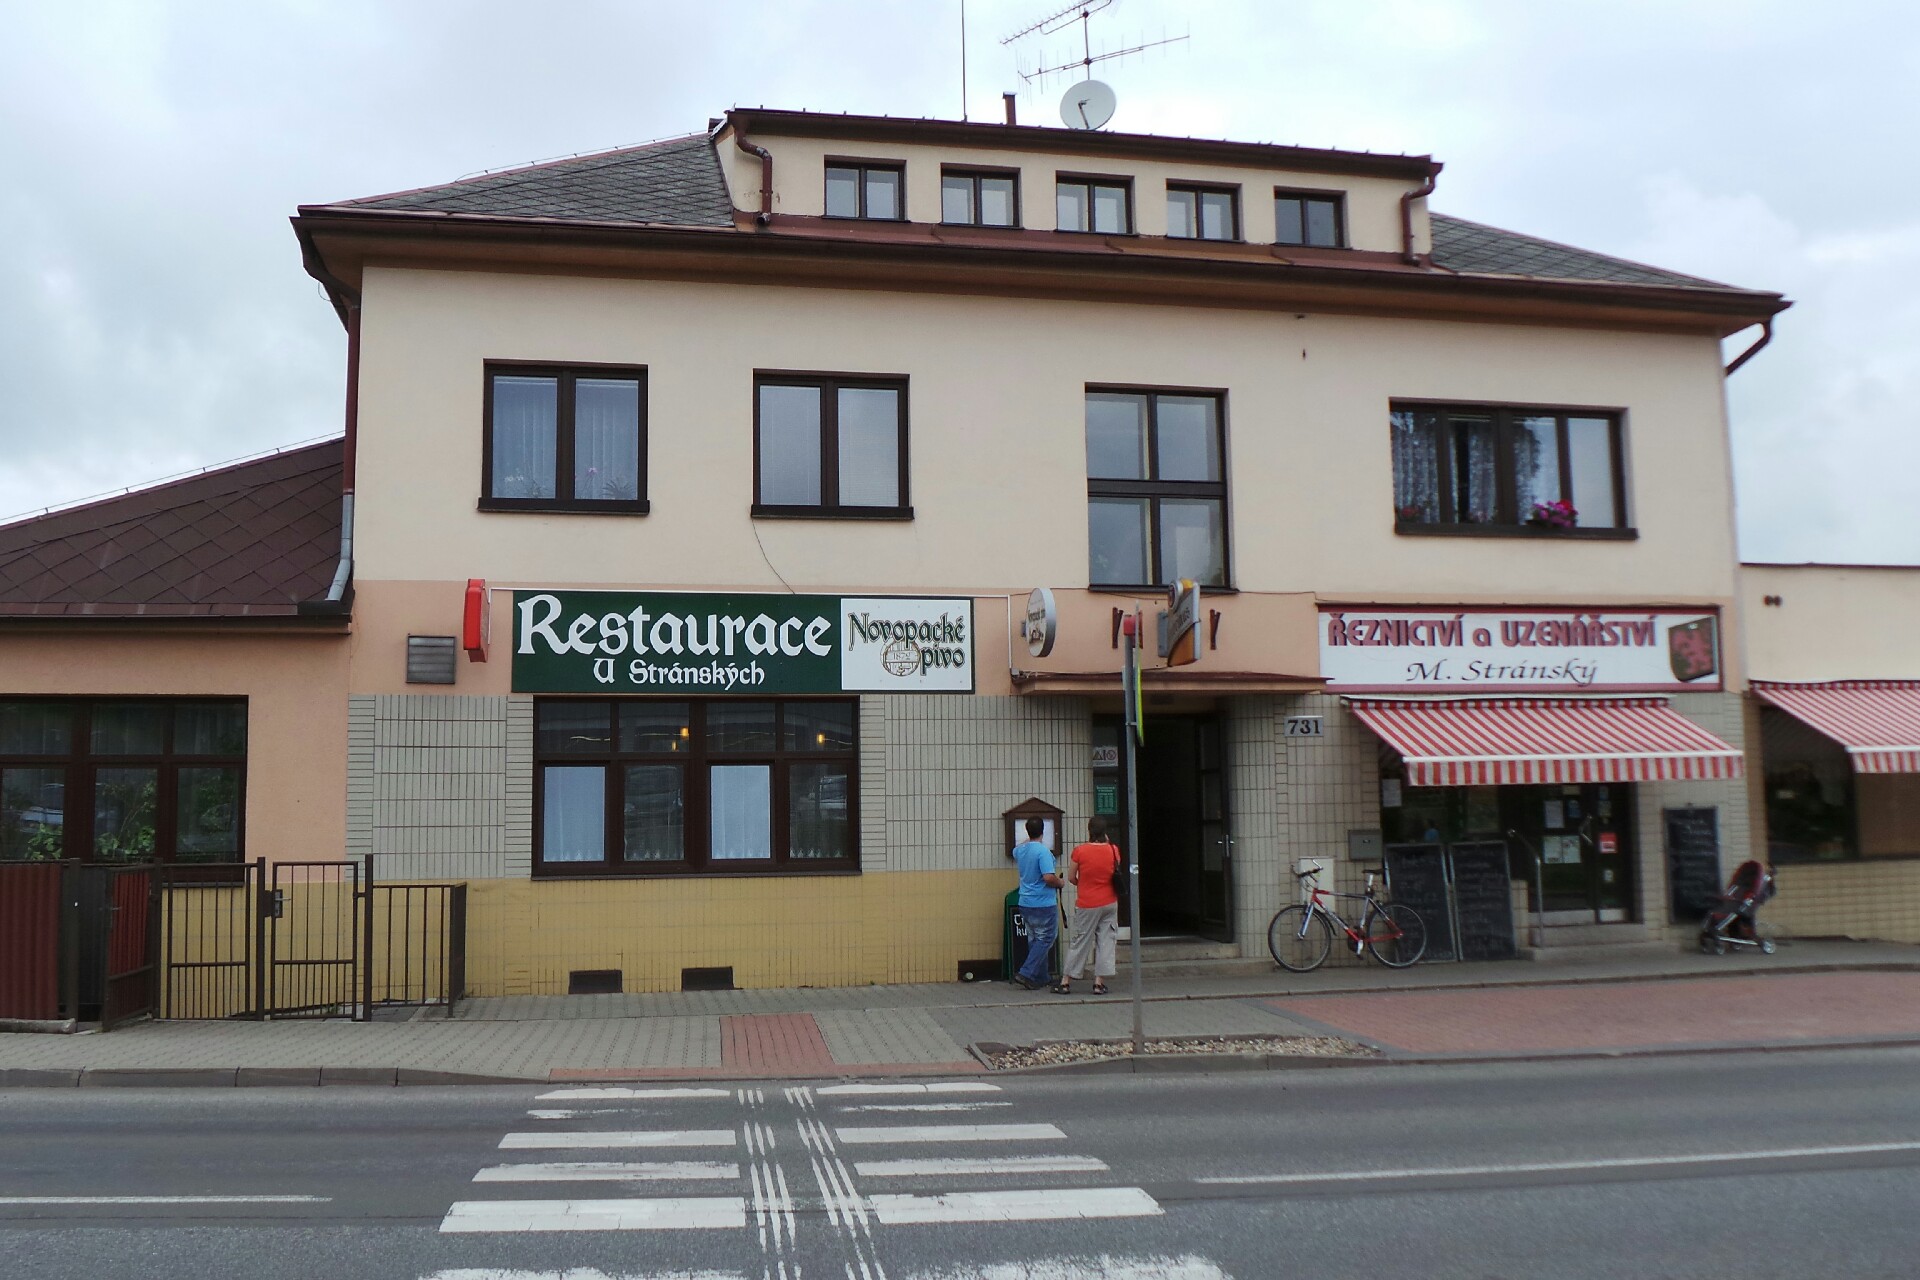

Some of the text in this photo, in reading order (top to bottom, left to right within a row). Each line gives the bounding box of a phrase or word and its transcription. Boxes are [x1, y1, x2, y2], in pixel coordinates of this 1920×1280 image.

[517, 594, 832, 657] Restaurace
[848, 612, 966, 651] Novopacké
[1328, 613, 1657, 647] ŘEZNICTVÍ a UZENÁŘSTVÍ
[593, 658, 765, 690] U Stránských
[920, 643, 966, 676] pivo
[1406, 657, 1598, 688] M. Stránský
[1287, 719, 1321, 735] 731
